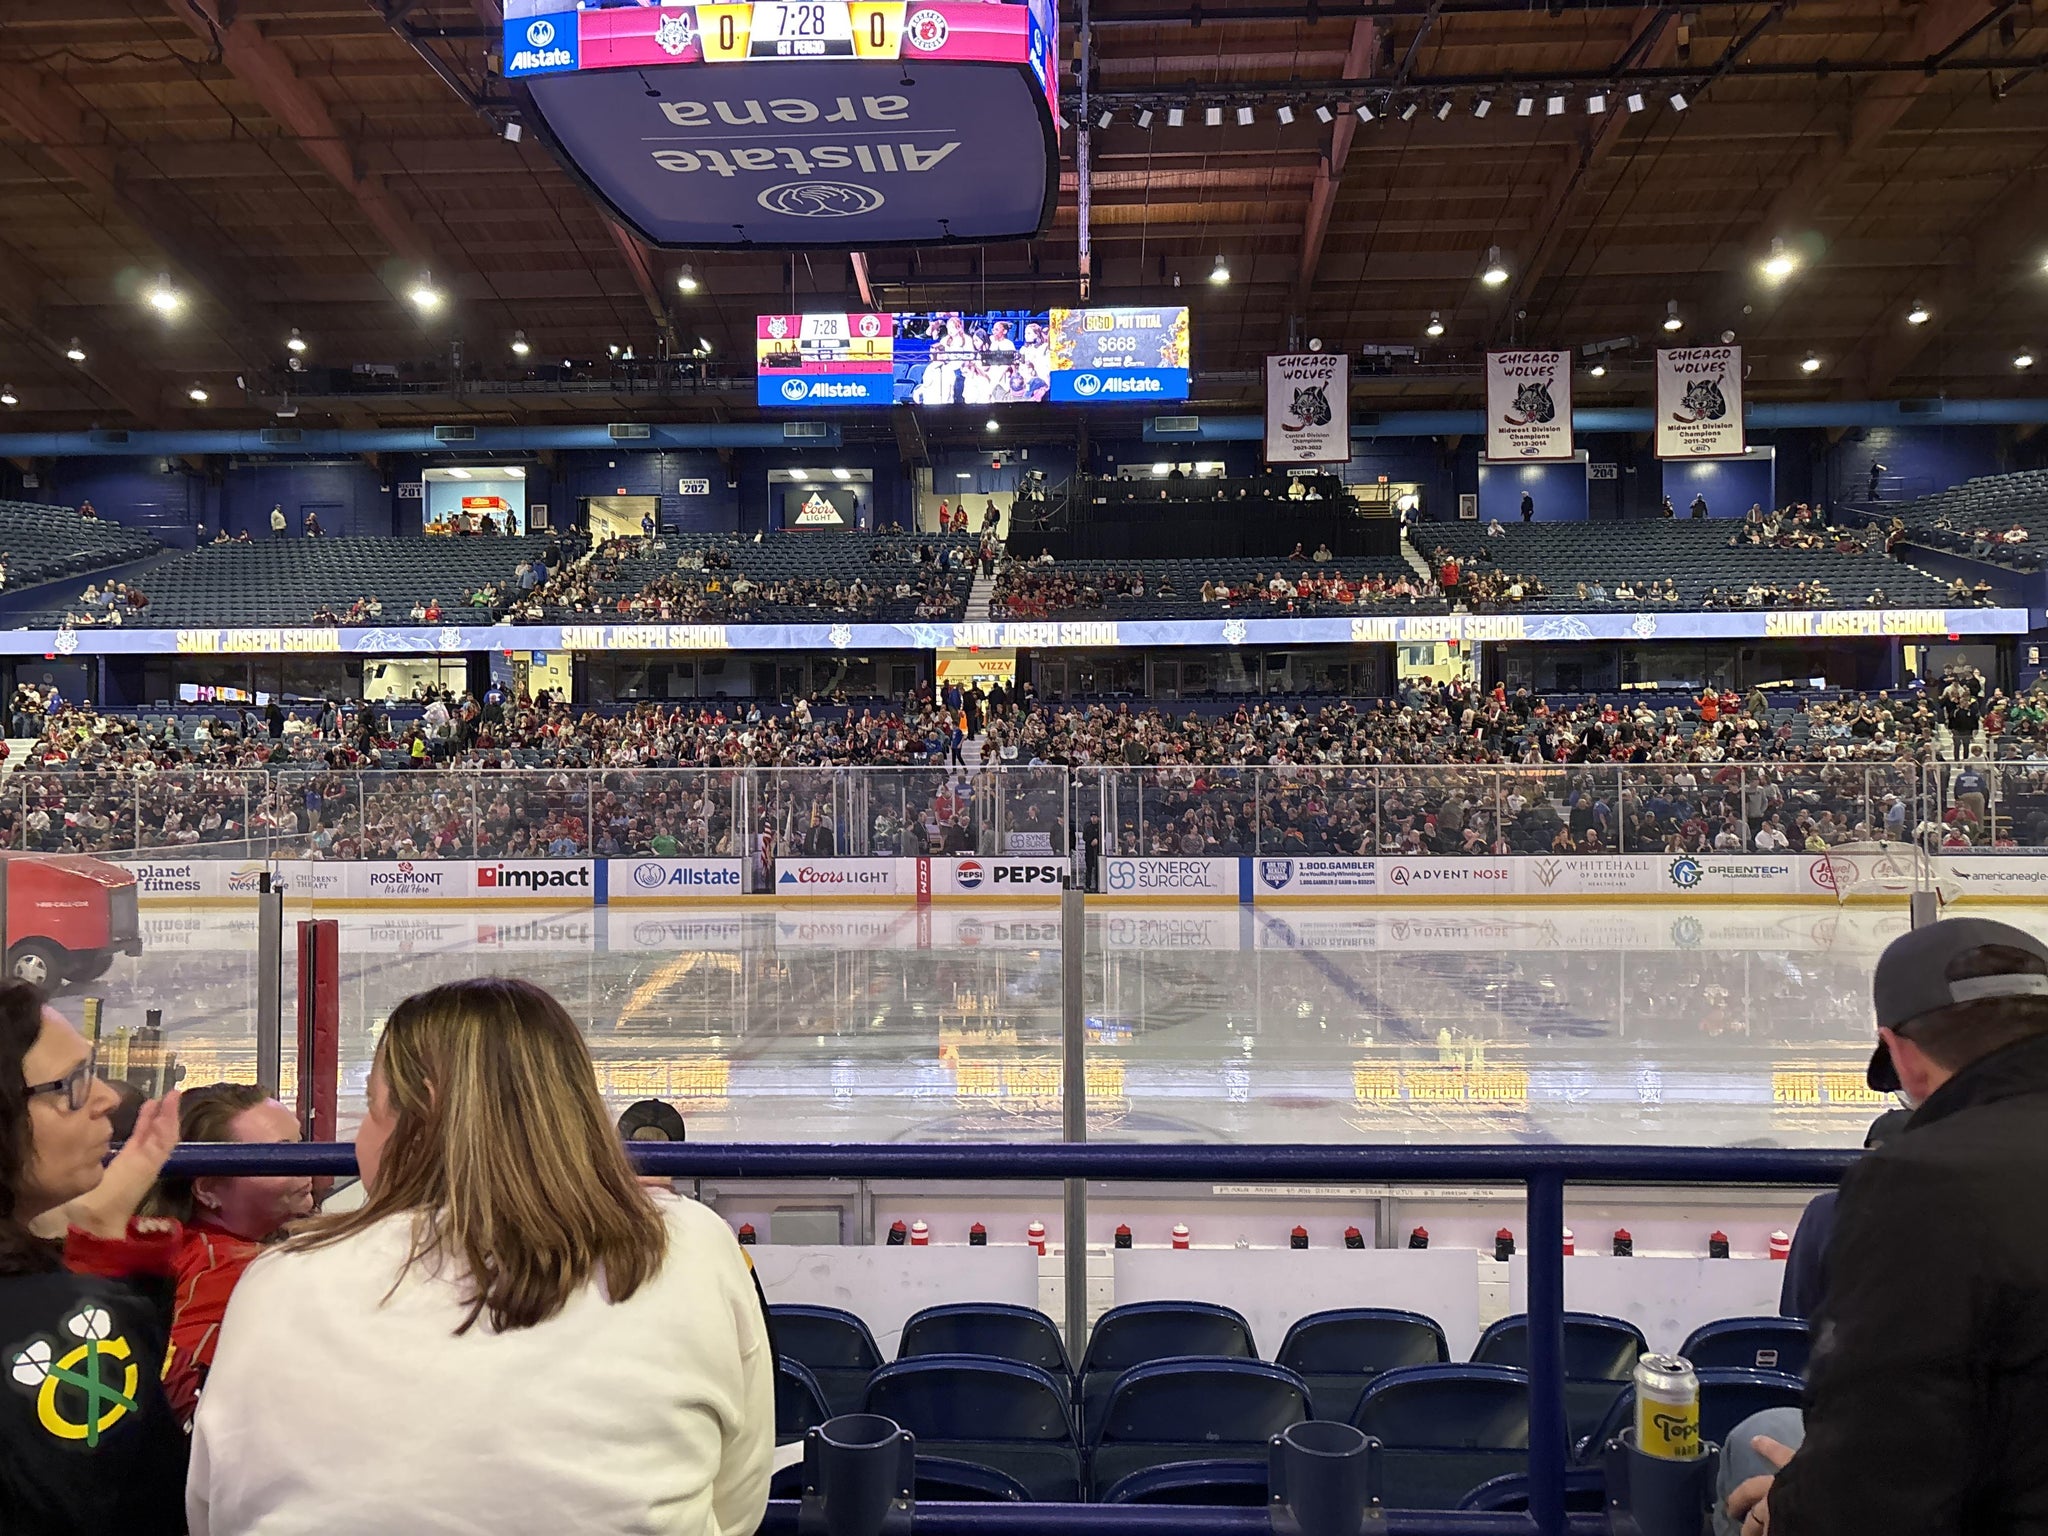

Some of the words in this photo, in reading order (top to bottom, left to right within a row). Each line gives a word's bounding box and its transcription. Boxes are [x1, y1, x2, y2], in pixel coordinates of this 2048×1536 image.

[776, 5, 825, 36] 7:28
[719, 15, 733, 50] 0
[870, 12, 884, 47] 0
[658, 95, 910, 126] arena
[651, 142, 962, 177] Allstate
[813, 319, 838, 335] 7:28
[1097, 336, 1137, 353] $668
[1278, 356, 1338, 367] CHICAGO
[1498, 353, 1560, 364] CHICAGO
[1668, 349, 1731, 361] CHICAGO
[1503, 366, 1555, 377] WOLVES
[1674, 361, 1727, 373] WOLVES
[1283, 368, 1334, 380] WOLVES
[1509, 433, 1550, 441] Champions
[1592, 468, 1614, 478] 204
[400, 488, 421, 497] 201
[684, 485, 705, 493] 202
[801, 502, 834, 514] Coors
[1351, 618, 1398, 640] SAINT
[1400, 618, 1461, 640] JOSEPH
[1464, 617, 1526, 638] SCHOOL
[1765, 612, 1812, 636] SAINT
[1815, 611, 1880, 635] JOSEPH
[1882, 610, 1948, 633] SCHOOL
[176, 630, 220, 652] SAINT
[222, 630, 281, 652] JOSEPH
[283, 629, 341, 651] SCHOOL
[561, 627, 606, 649] SAINT
[607, 627, 666, 648] JOSEPH
[669, 626, 728, 648] SCHOOL
[953, 624, 998, 645] SAINT
[999, 624, 1058, 645] JOSEPH
[1060, 623, 1119, 644] SCHOOL
[979, 662, 1012, 670] VIZZY
[1139, 861, 1211, 874] SYNERGY
[1298, 862, 1375, 870] 1.800.GAMBLER
[1565, 861, 1650, 871] WHITEHALL
[1707, 865, 1789, 874] GREENTECH
[1816, 863, 1851, 873] Jewel
[137, 865, 191, 882] planet
[370, 872, 443, 886] ROSEMONT
[497, 864, 590, 891] impact
[668, 868, 740, 885] Allstate
[798, 867, 844, 883] Coors
[847, 872, 889, 883] LIGHT
[920, 860, 928, 894] CCM
[993, 866, 1062, 883] PEPSI
[1412, 869, 1469, 880] ADVENT
[1473, 869, 1508, 880] NOSE
[1818, 873, 1850, 883] Osco
[144, 876, 201, 892] fitness
[1139, 874, 1212, 887] SURGICAL
